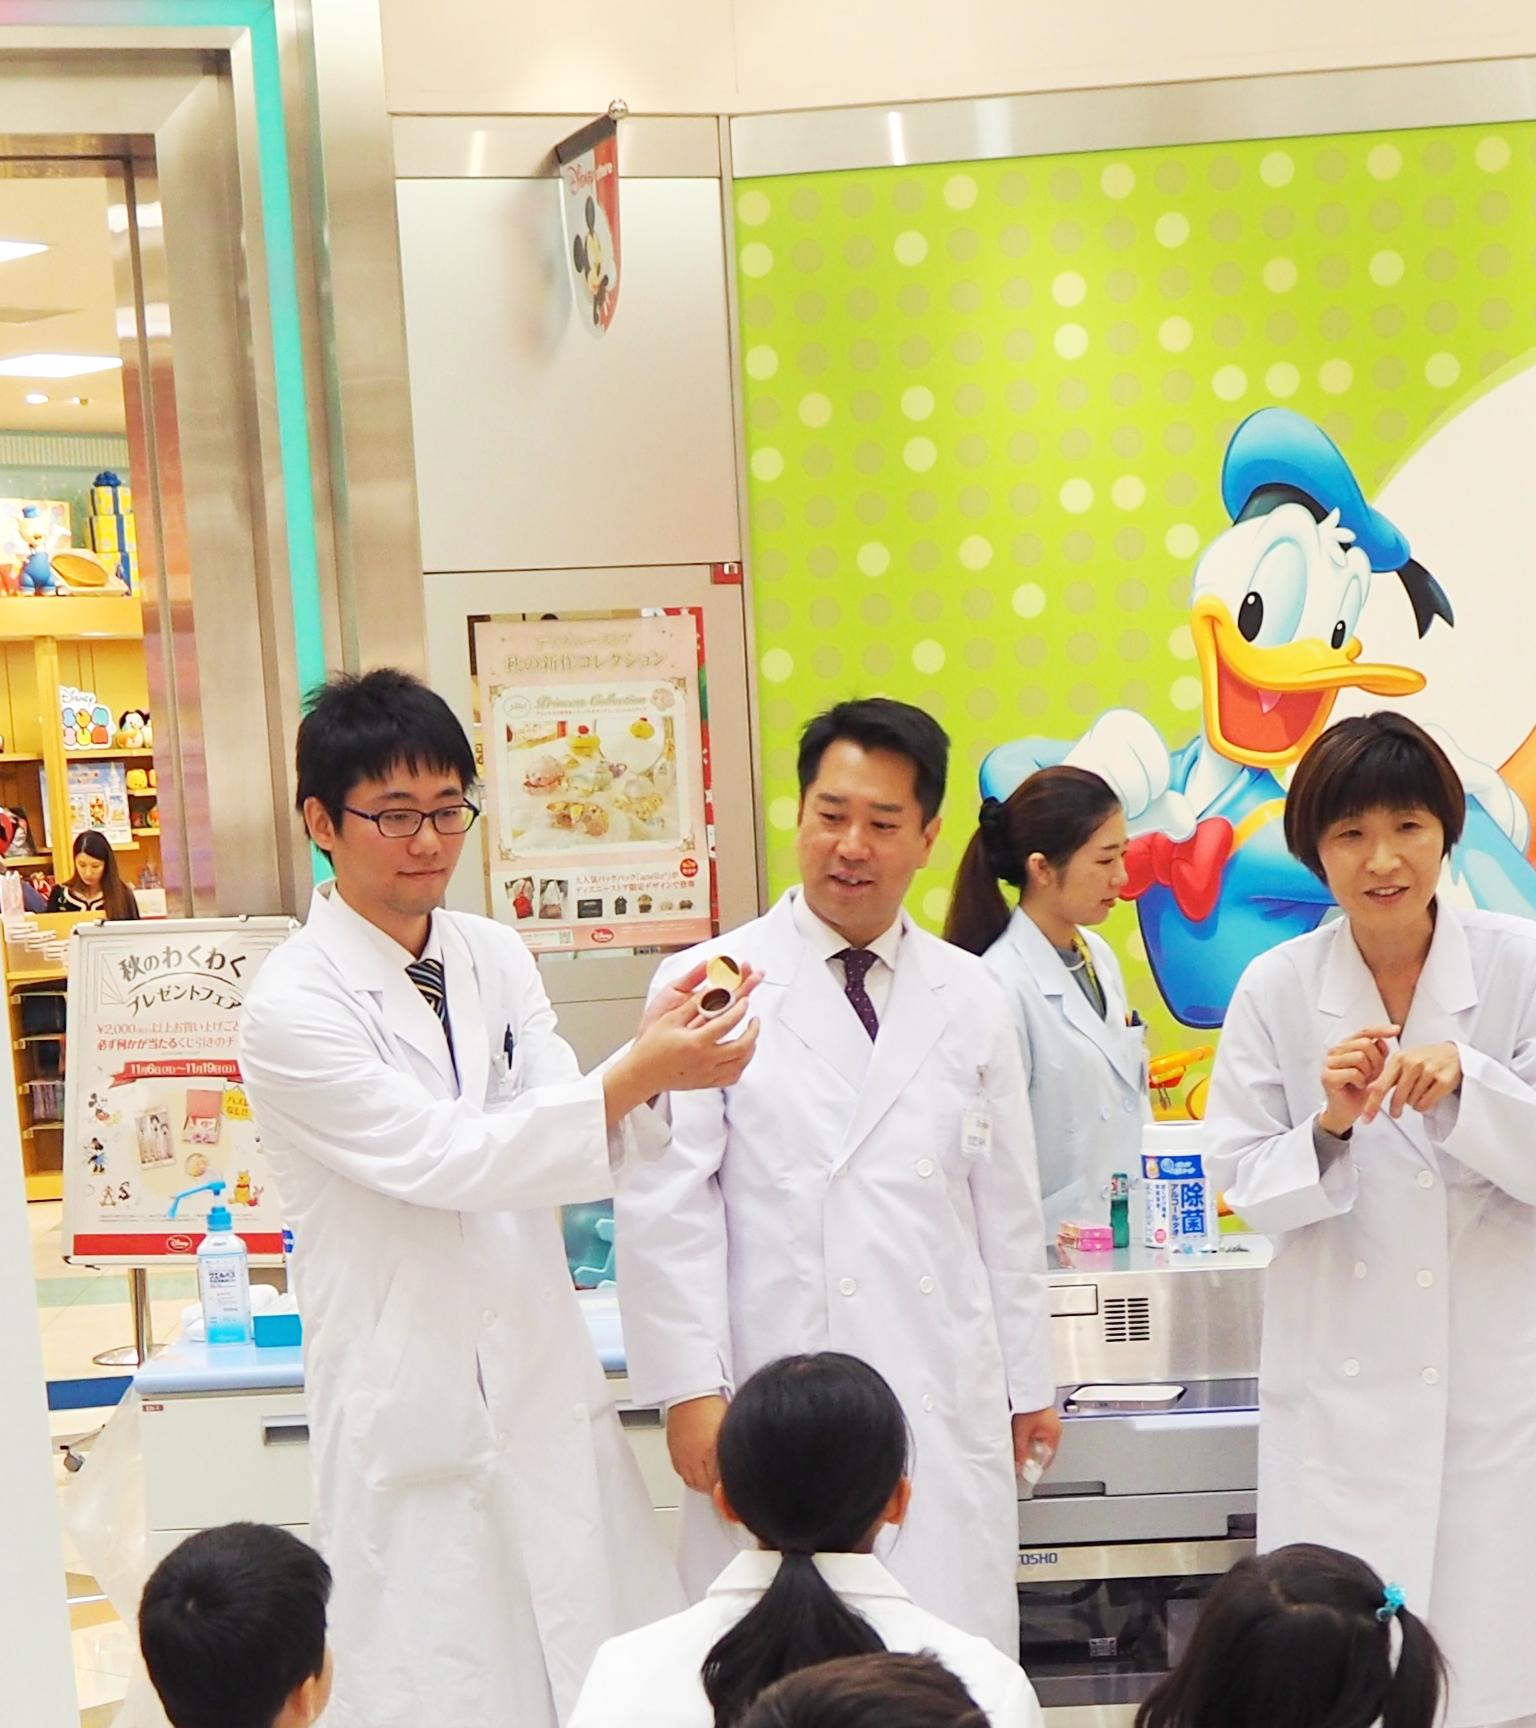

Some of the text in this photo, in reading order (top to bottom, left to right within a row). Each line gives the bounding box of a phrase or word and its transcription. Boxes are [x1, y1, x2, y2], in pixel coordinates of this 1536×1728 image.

[118, 944, 247, 983] 秋のわくわく
[126, 984, 242, 1017] プレゼントフェア
[1181, 1182, 1205, 1235] 除菌
